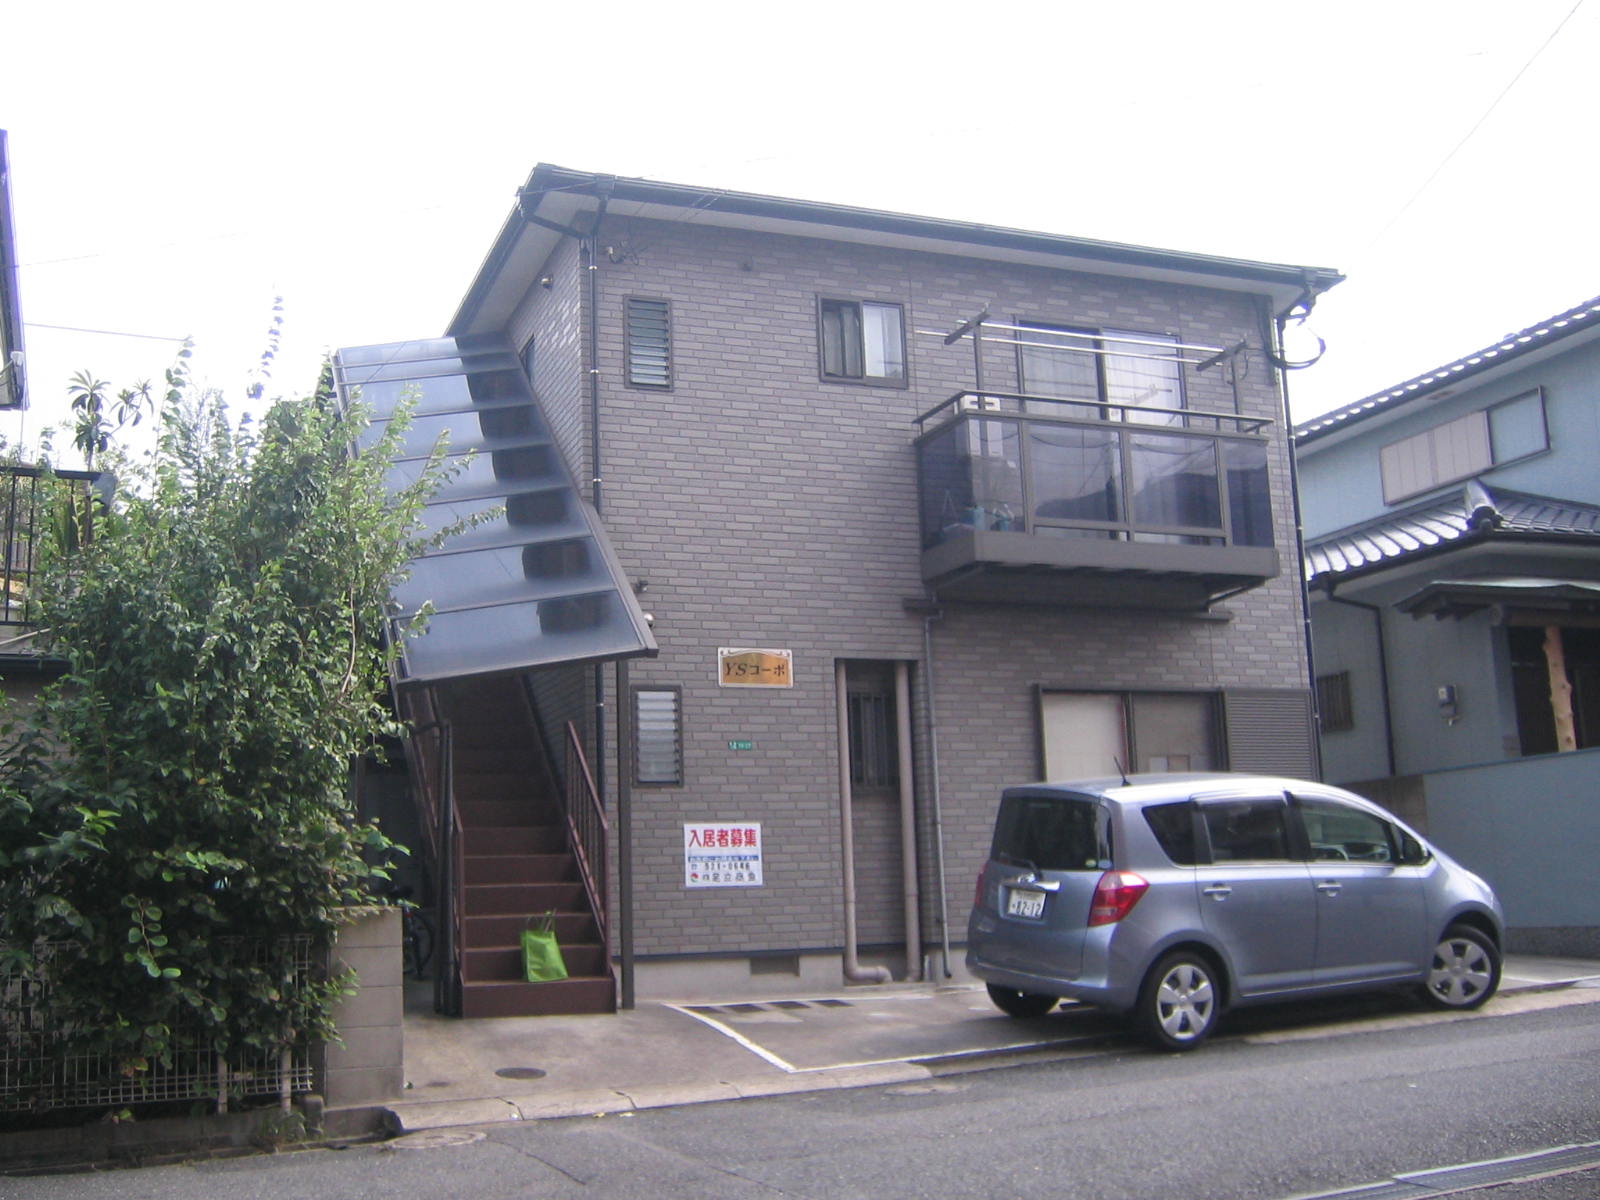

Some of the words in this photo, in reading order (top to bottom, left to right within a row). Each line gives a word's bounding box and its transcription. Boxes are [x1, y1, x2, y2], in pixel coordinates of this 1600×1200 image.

[688, 828, 757, 848] 入居者募集
